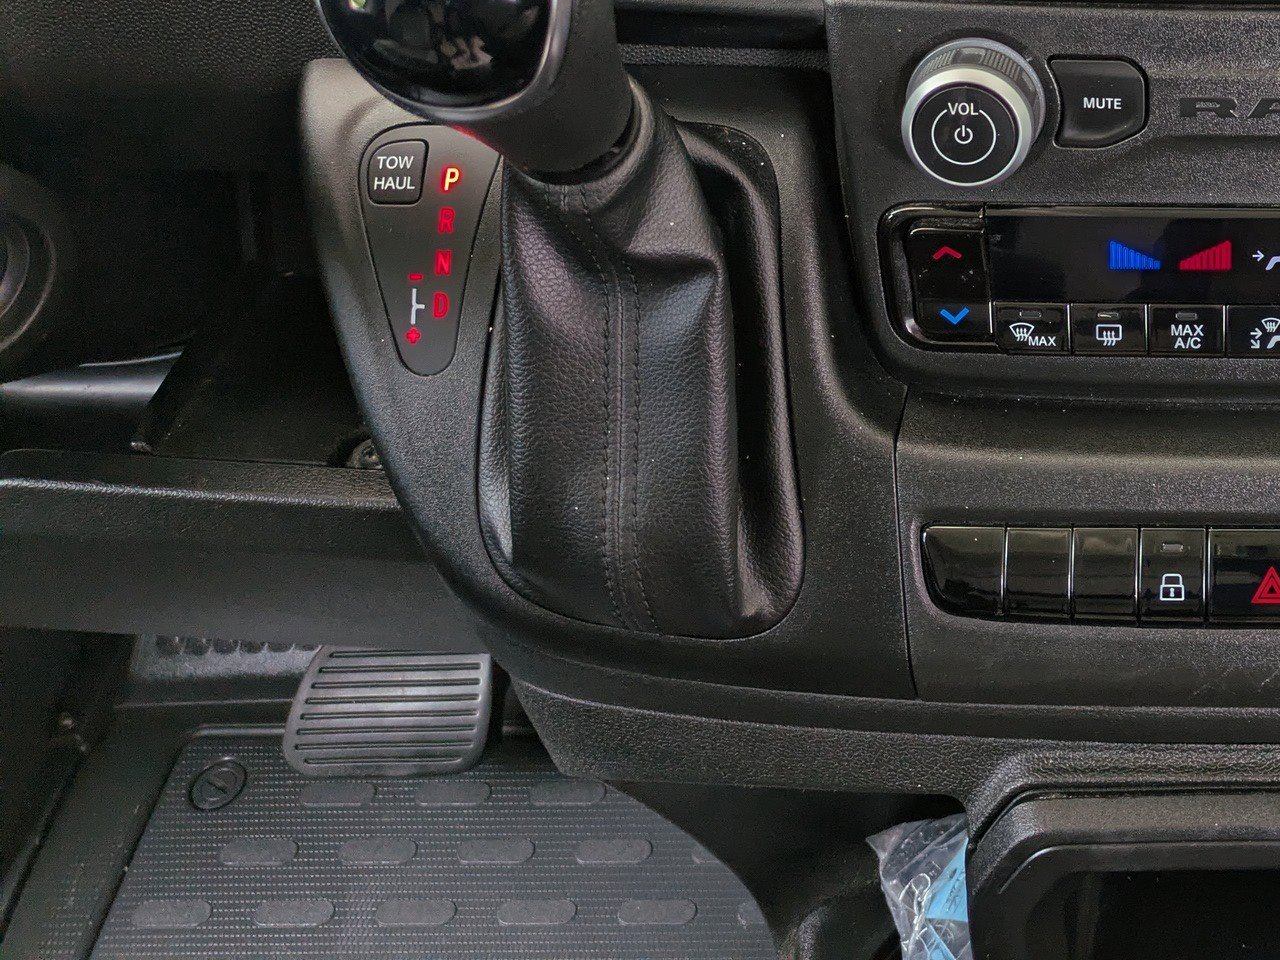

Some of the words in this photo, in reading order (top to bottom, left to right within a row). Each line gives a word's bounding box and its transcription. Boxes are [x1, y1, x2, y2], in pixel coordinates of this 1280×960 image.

[947, 102, 979, 116] VOL
[1082, 97, 1122, 110] MUTE
[377, 155, 415, 170] TOW
[373, 176, 416, 191] HAUL
[443, 167, 461, 192] P
[438, 207, 456, 234] R
[434, 249, 452, 276] N
[432, 291, 449, 319] D
[1170, 324, 1205, 337] MAX
[1028, 336, 1057, 347] MAX
[1174, 337, 1202, 350] A/C
